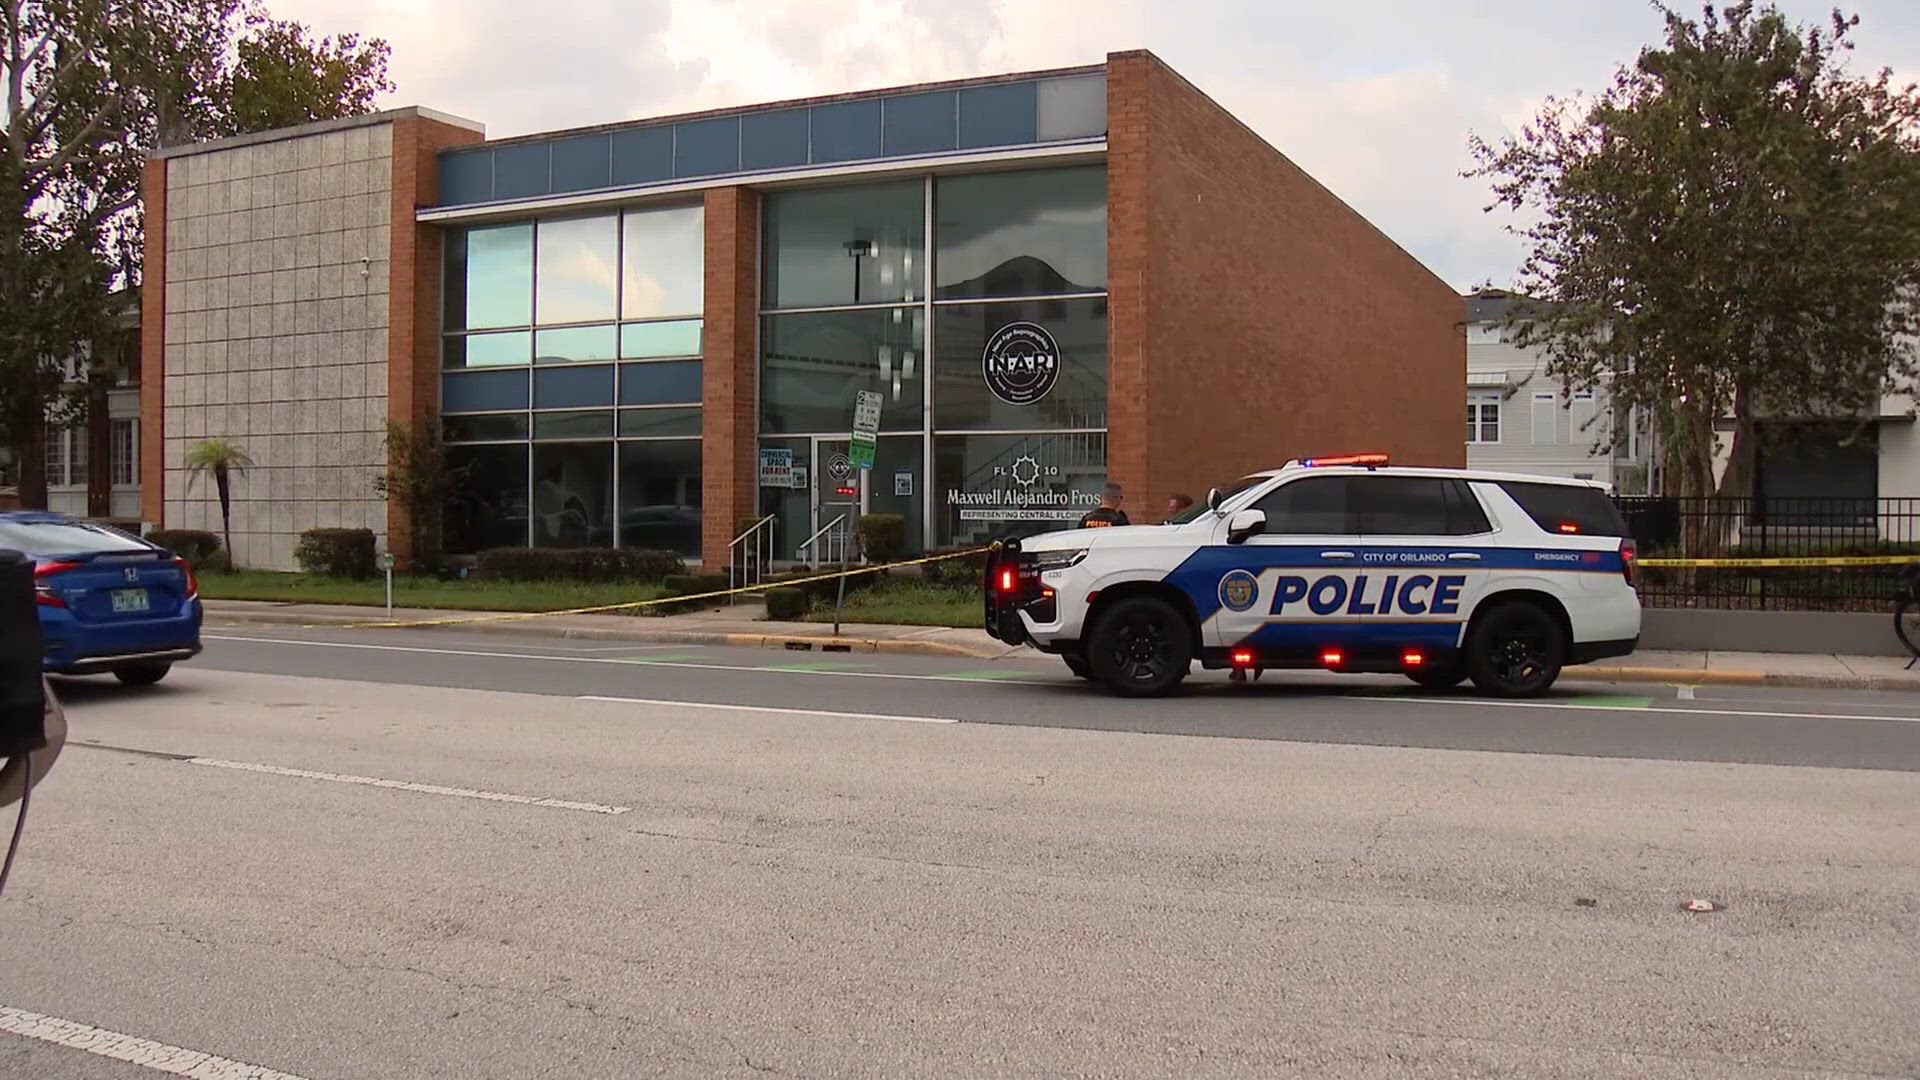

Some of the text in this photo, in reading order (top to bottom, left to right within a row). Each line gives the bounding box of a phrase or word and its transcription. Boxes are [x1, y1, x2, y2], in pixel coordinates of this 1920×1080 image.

[767, 458, 787, 467] SPACE
[762, 466, 790, 475] FOR RENT
[993, 466, 1058, 476] FL 10
[947, 489, 1102, 508] Maxwell Alejandro Fros
[962, 511, 1019, 519] REPRESENTING
[1020, 511, 1054, 519] CENTRAL
[1363, 553, 1446, 562] CITY OF ORLANDO
[1534, 552, 1579, 561] EMERGENCY
[1269, 575, 1467, 616] POLICE
